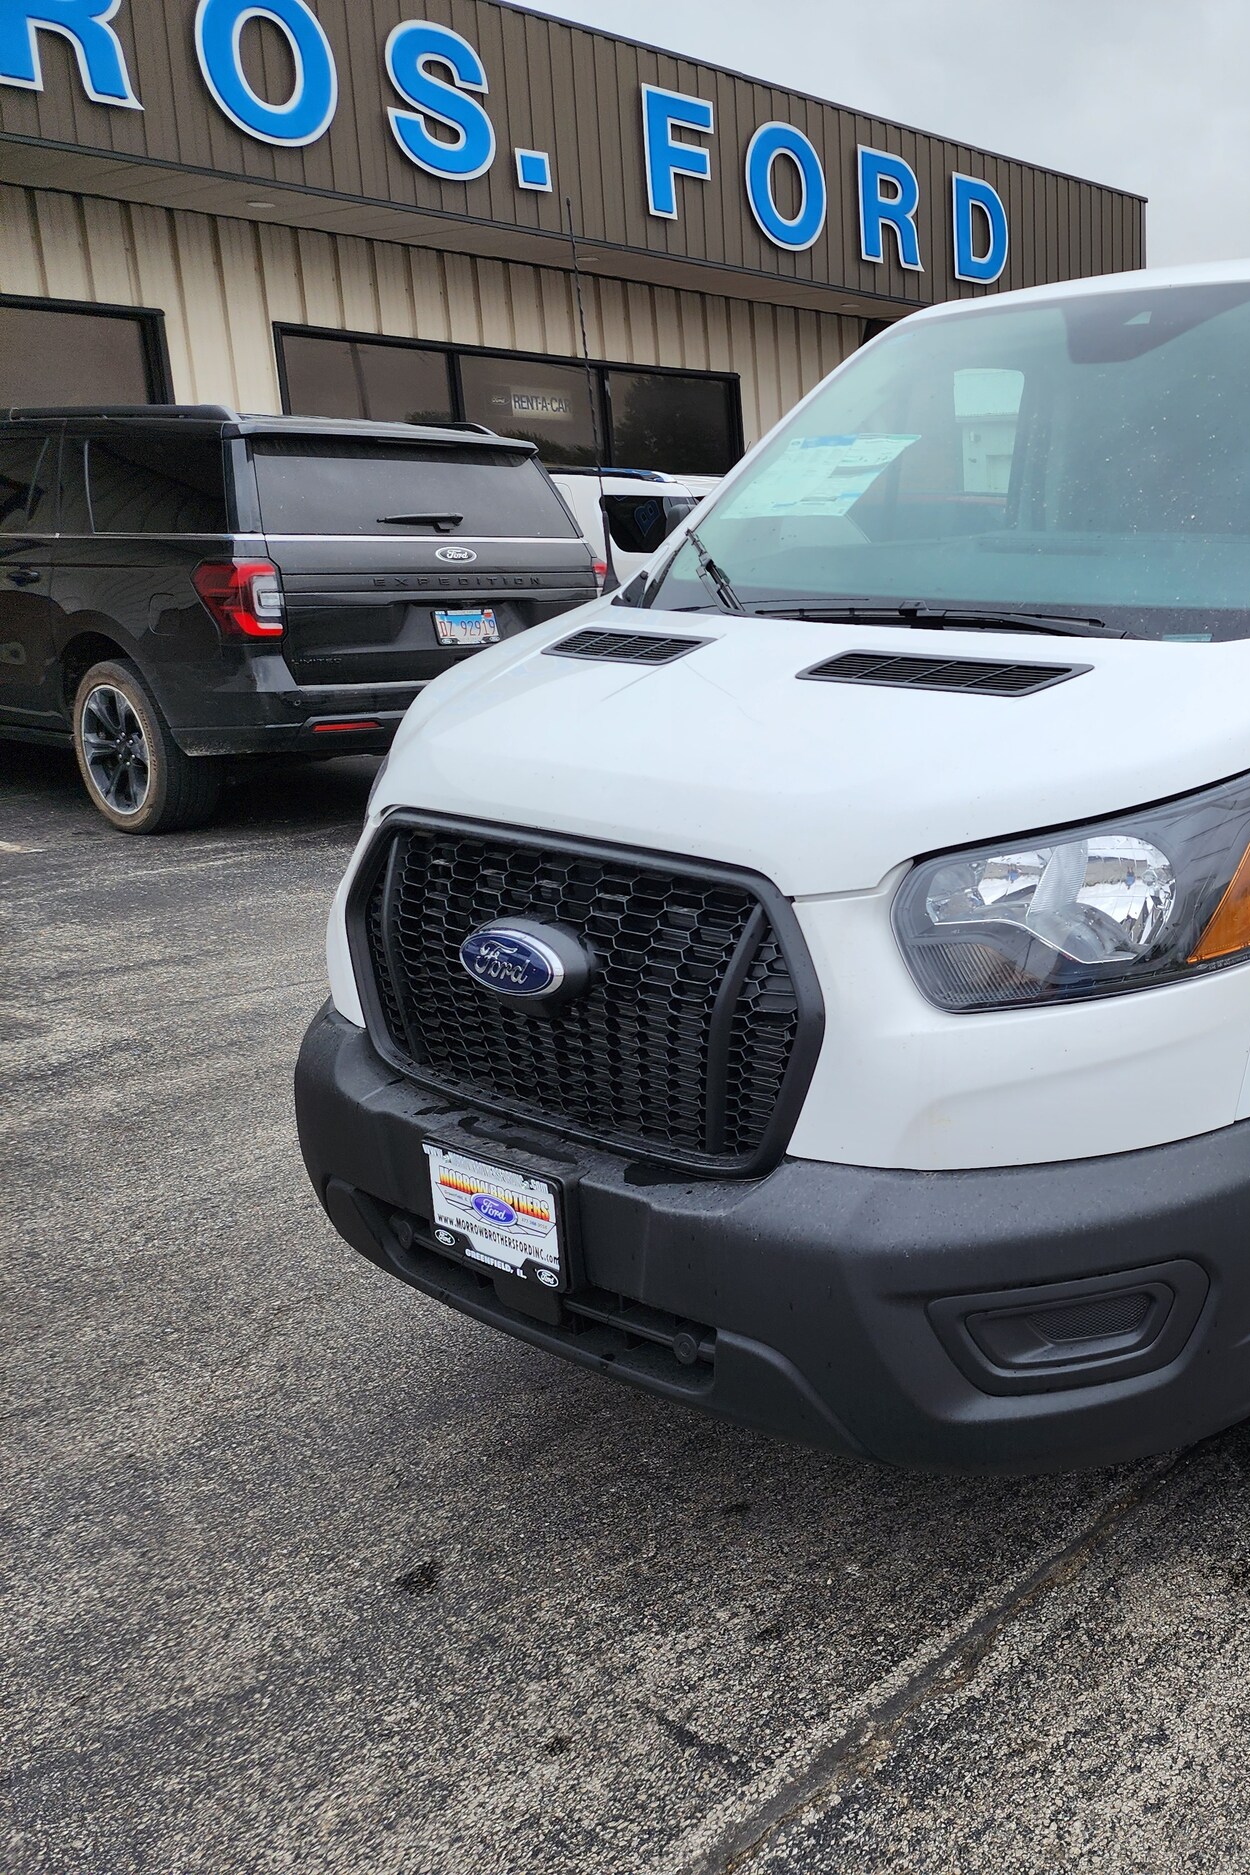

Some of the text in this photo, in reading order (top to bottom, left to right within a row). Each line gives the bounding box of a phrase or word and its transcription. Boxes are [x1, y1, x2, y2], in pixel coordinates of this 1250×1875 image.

[641, 82, 1009, 285] FORD
[373, 577, 541, 587] EXPEDITION
[439, 619, 496, 637] DZ 92919
[474, 940, 531, 985] Ford
[439, 1165, 491, 1196] MORROW
[481, 1199, 507, 1221] Ford
